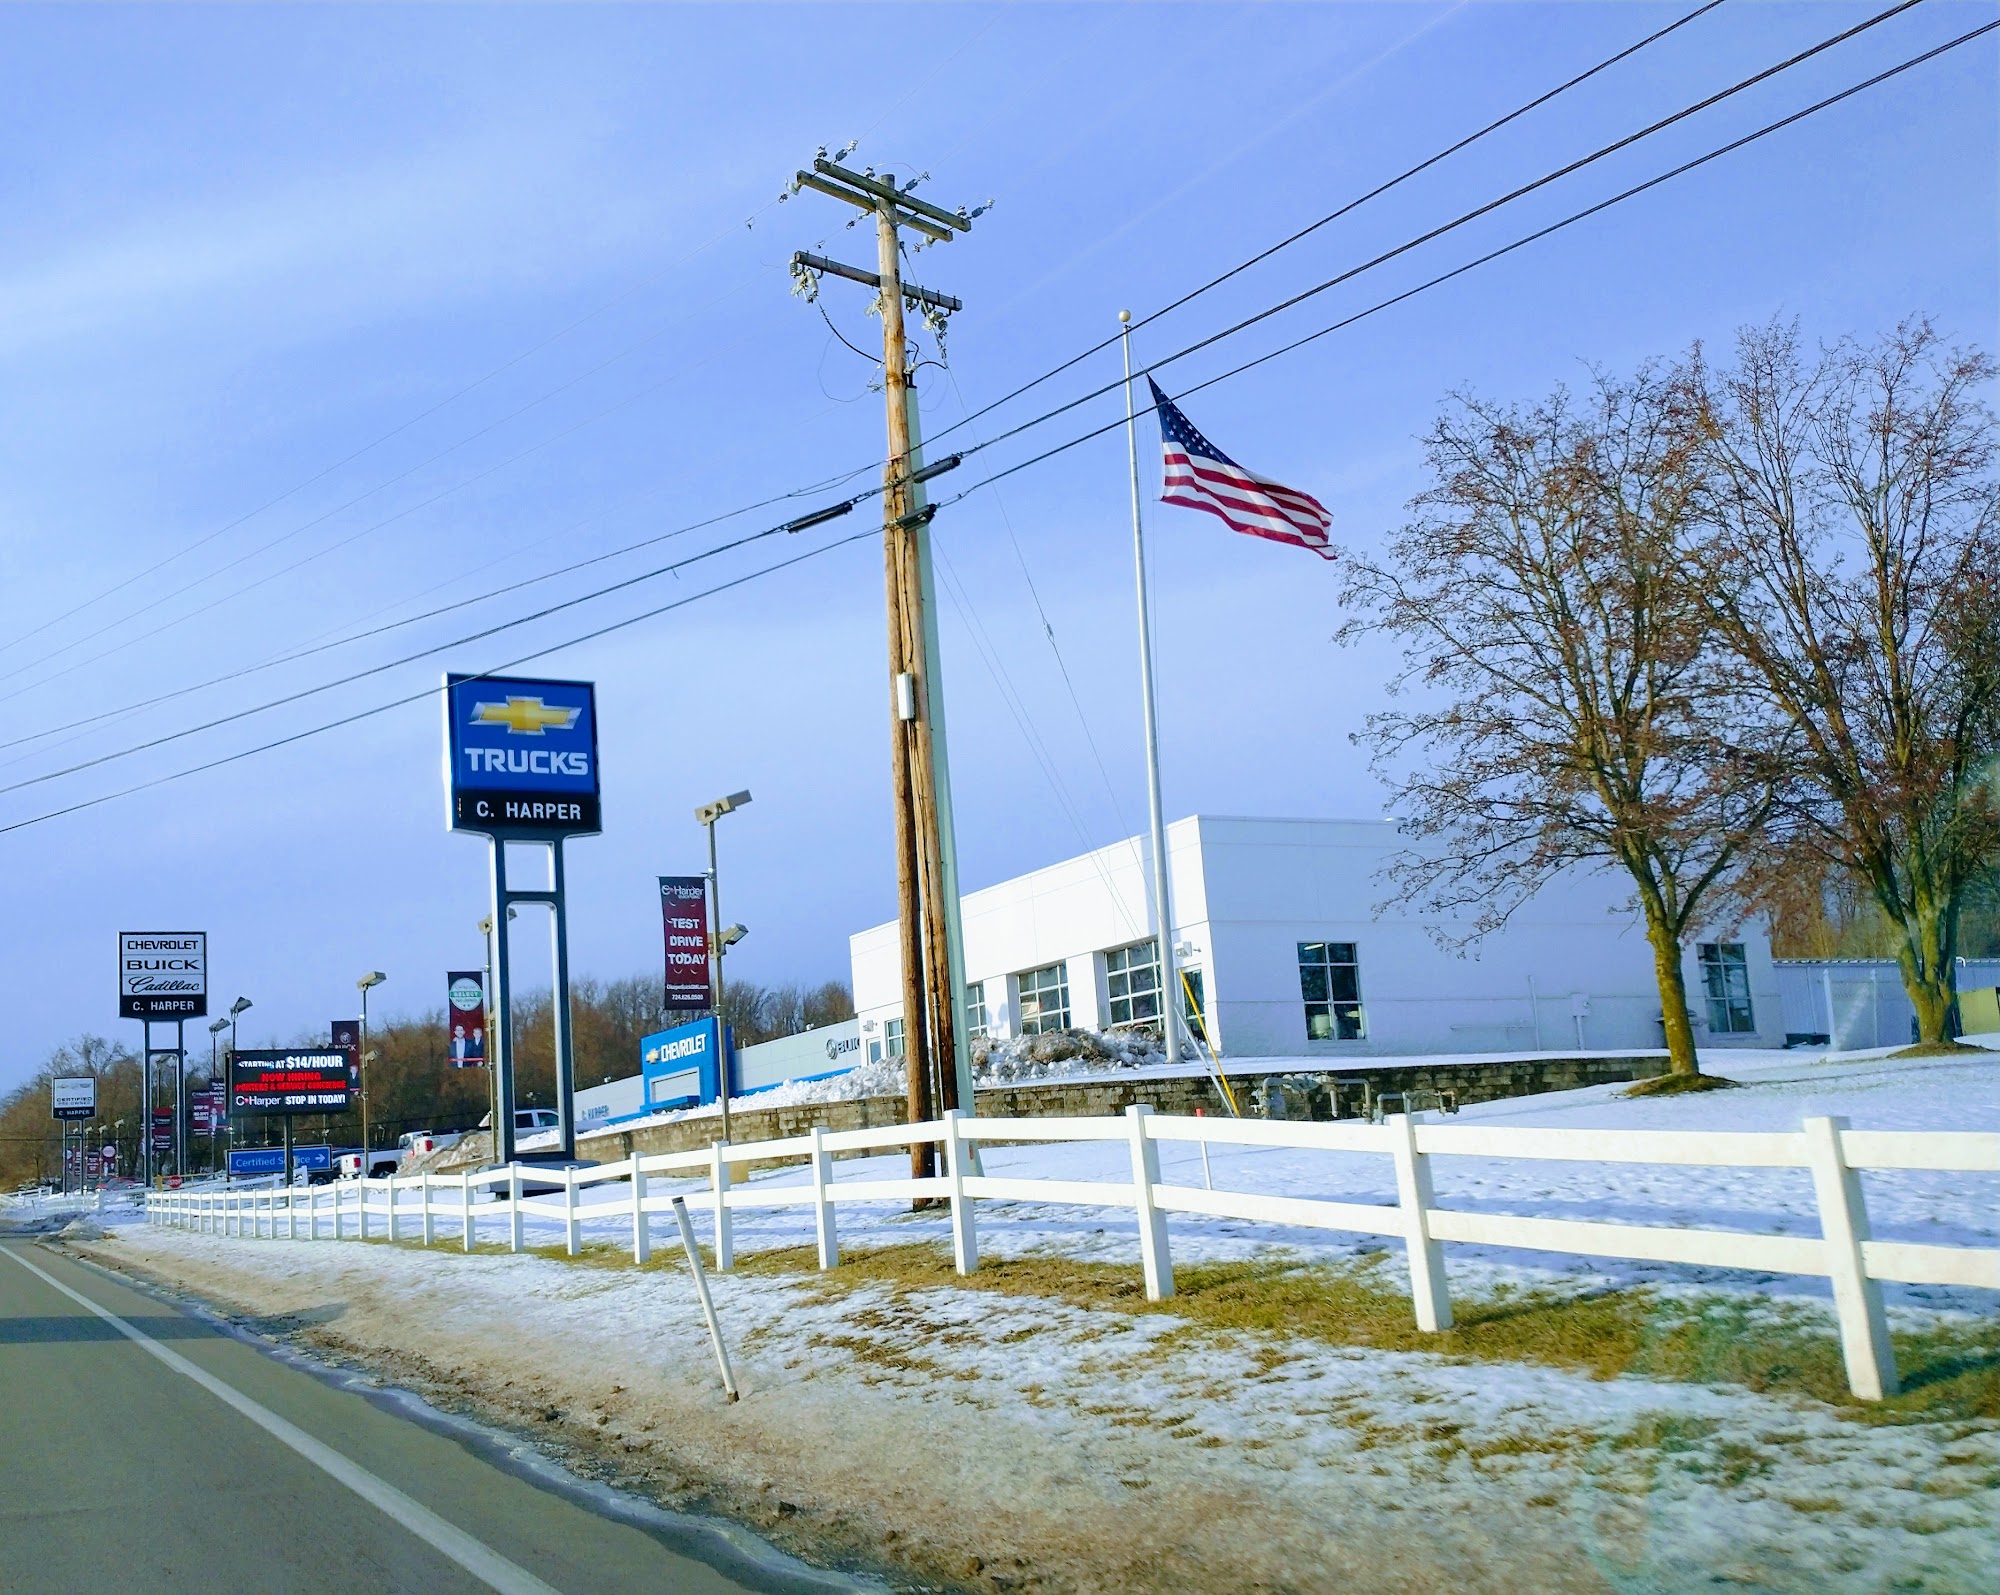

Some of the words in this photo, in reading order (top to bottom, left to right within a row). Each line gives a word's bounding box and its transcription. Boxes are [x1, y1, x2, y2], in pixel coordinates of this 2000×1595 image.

[464, 748, 588, 776] TRUCKS
[476, 801, 495, 818] C.
[506, 802, 581, 820] HARPER
[670, 918, 700, 929] TEST
[127, 940, 198, 950] CHEVROLET
[670, 936, 703, 947] DRIVE
[668, 952, 706, 965] TODAY
[127, 959, 200, 970] BUICK
[128, 976, 200, 993] Cadillac
[132, 1001, 144, 1011] C.
[150, 1000, 195, 1011] HARPER
[661, 1032, 706, 1063] CHEVROLET
[238, 1060, 274, 1069] STARTING
[275, 1060, 286, 1069] AT
[286, 1055, 344, 1070] $14/HOUR
[260, 1072, 285, 1082] NOW
[287, 1071, 322, 1082] HIRING
[285, 1095, 306, 1105] STOP
[308, 1095, 317, 1104] IN
[318, 1094, 346, 1104] TODAY!
[235, 1157, 276, 1168] Certified
